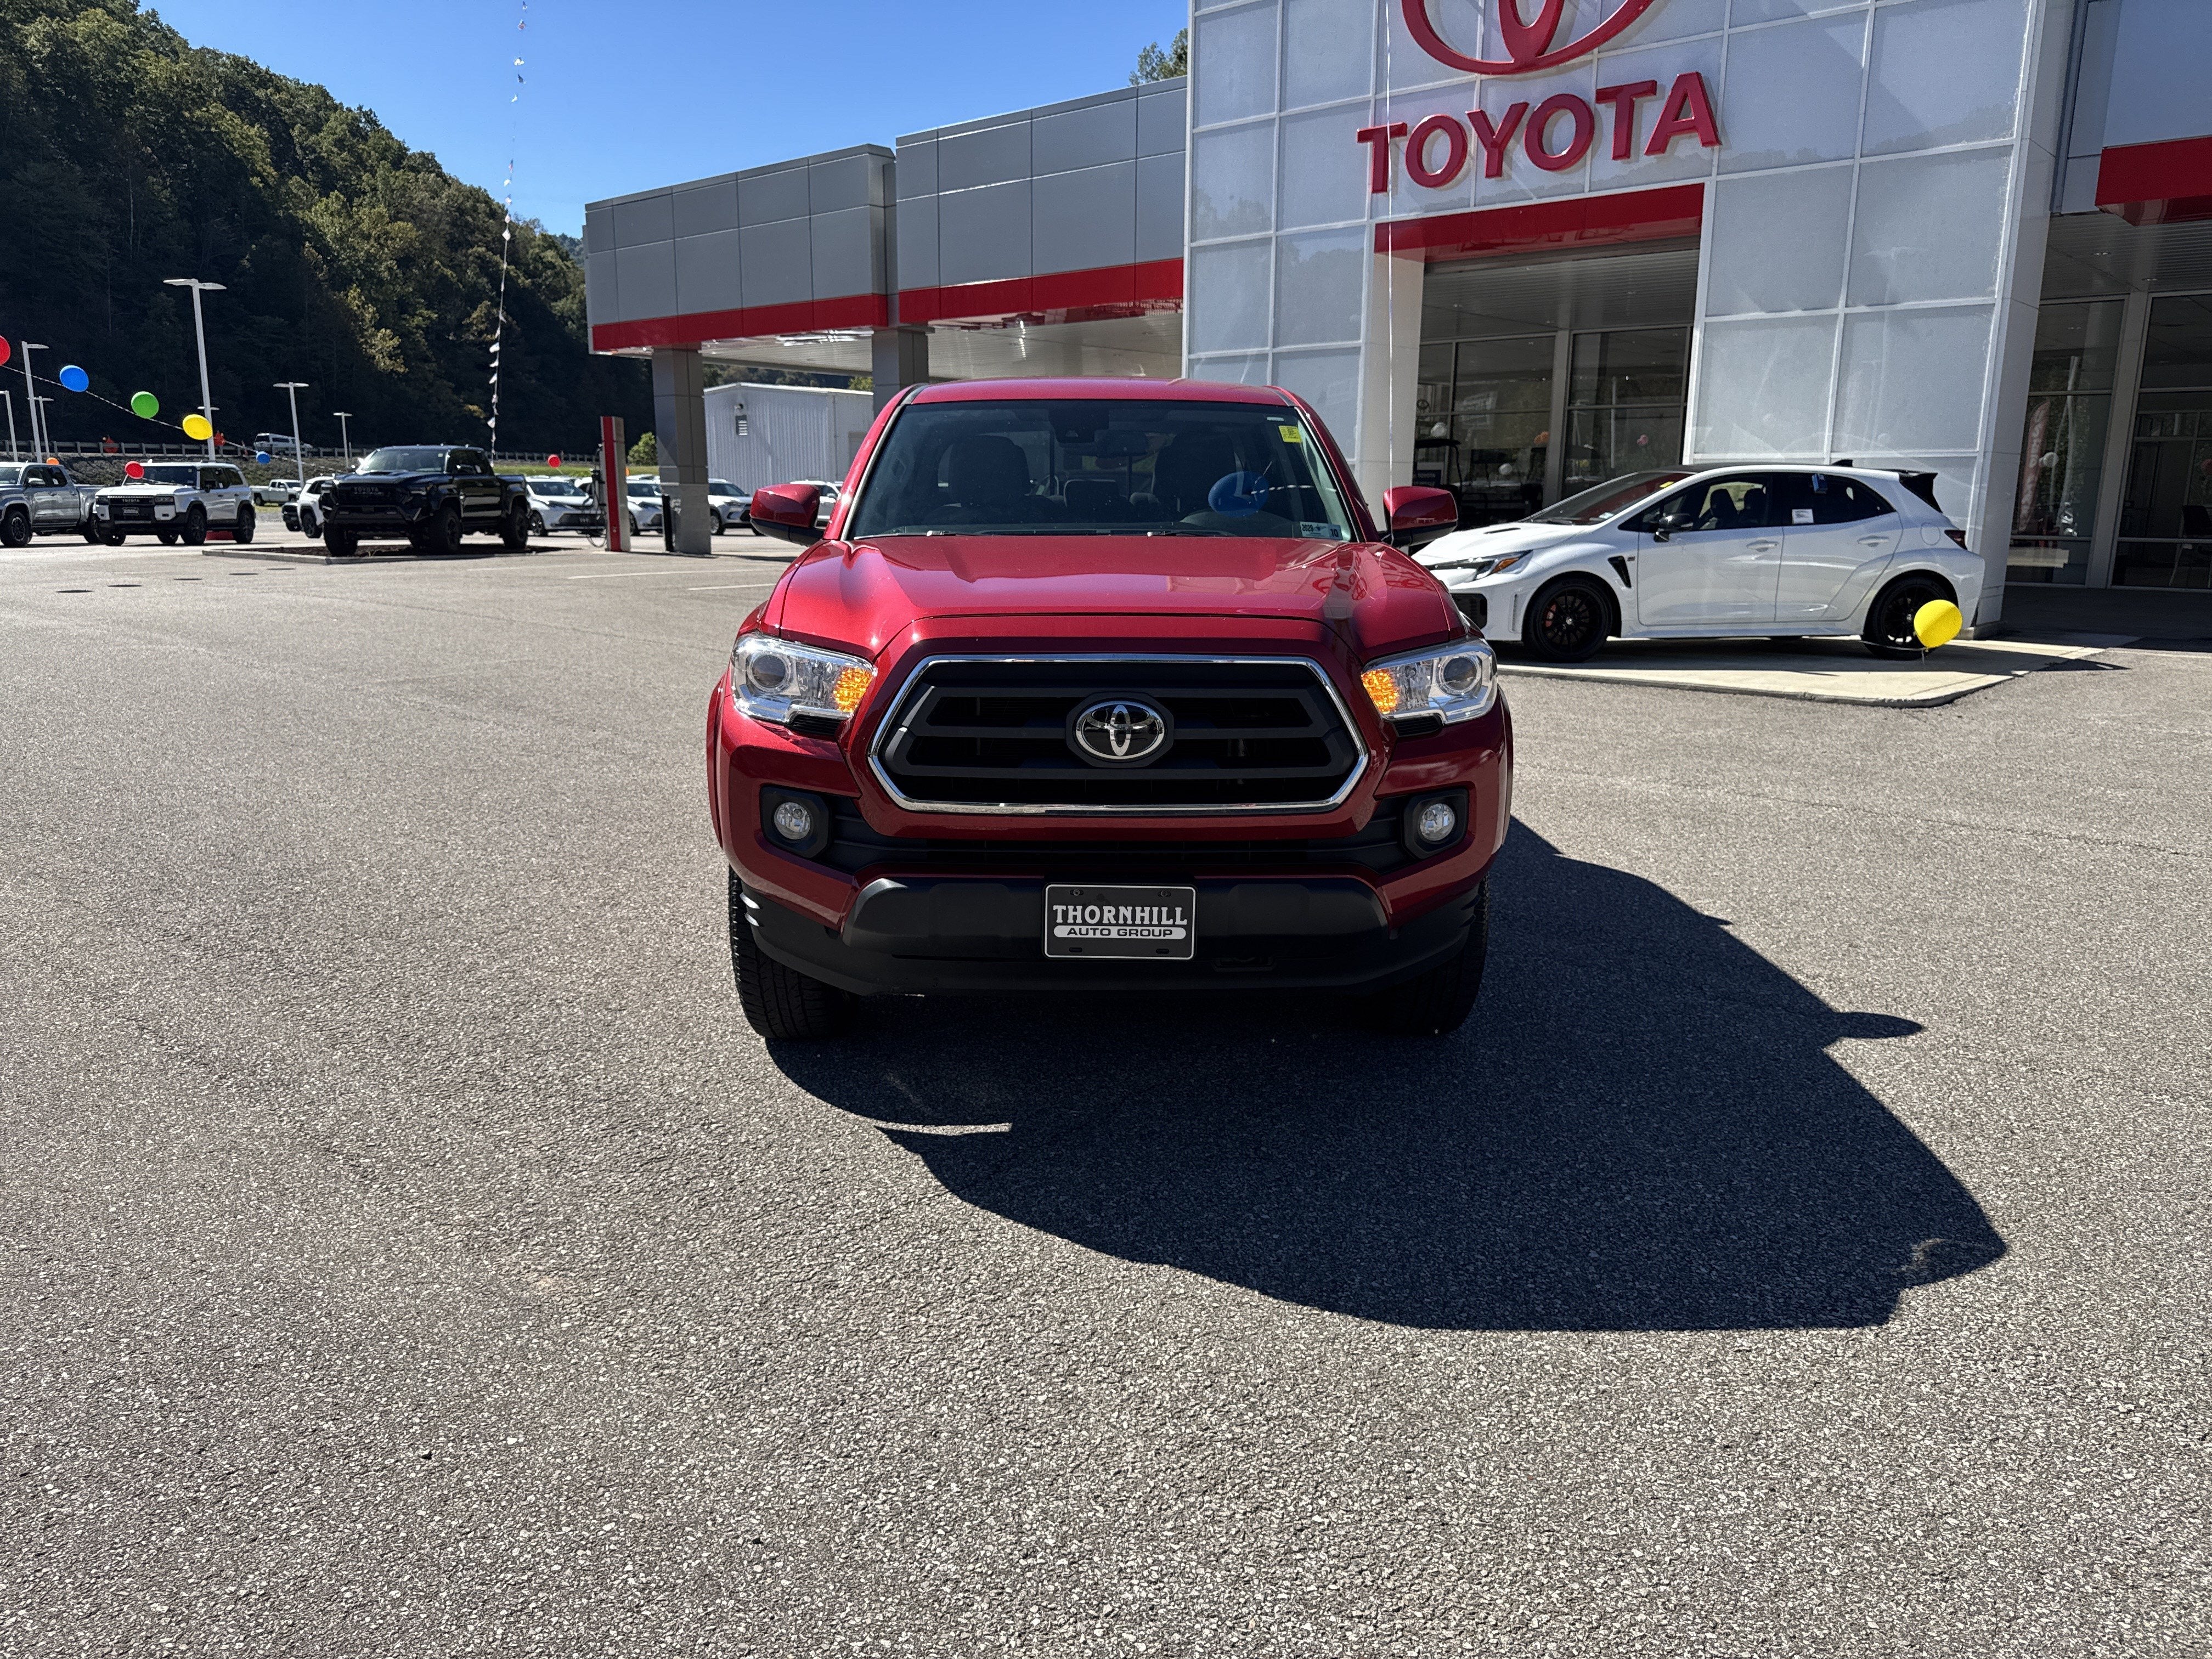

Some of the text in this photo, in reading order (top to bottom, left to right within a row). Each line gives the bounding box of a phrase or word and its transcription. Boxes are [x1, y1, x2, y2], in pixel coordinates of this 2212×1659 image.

[1357, 71, 1723, 194] TOYOTA
[1330, 528, 1339, 538] 10
[1053, 905, 1187, 925] THORNHILL
[1066, 928, 1173, 937] AUTO GROUP
